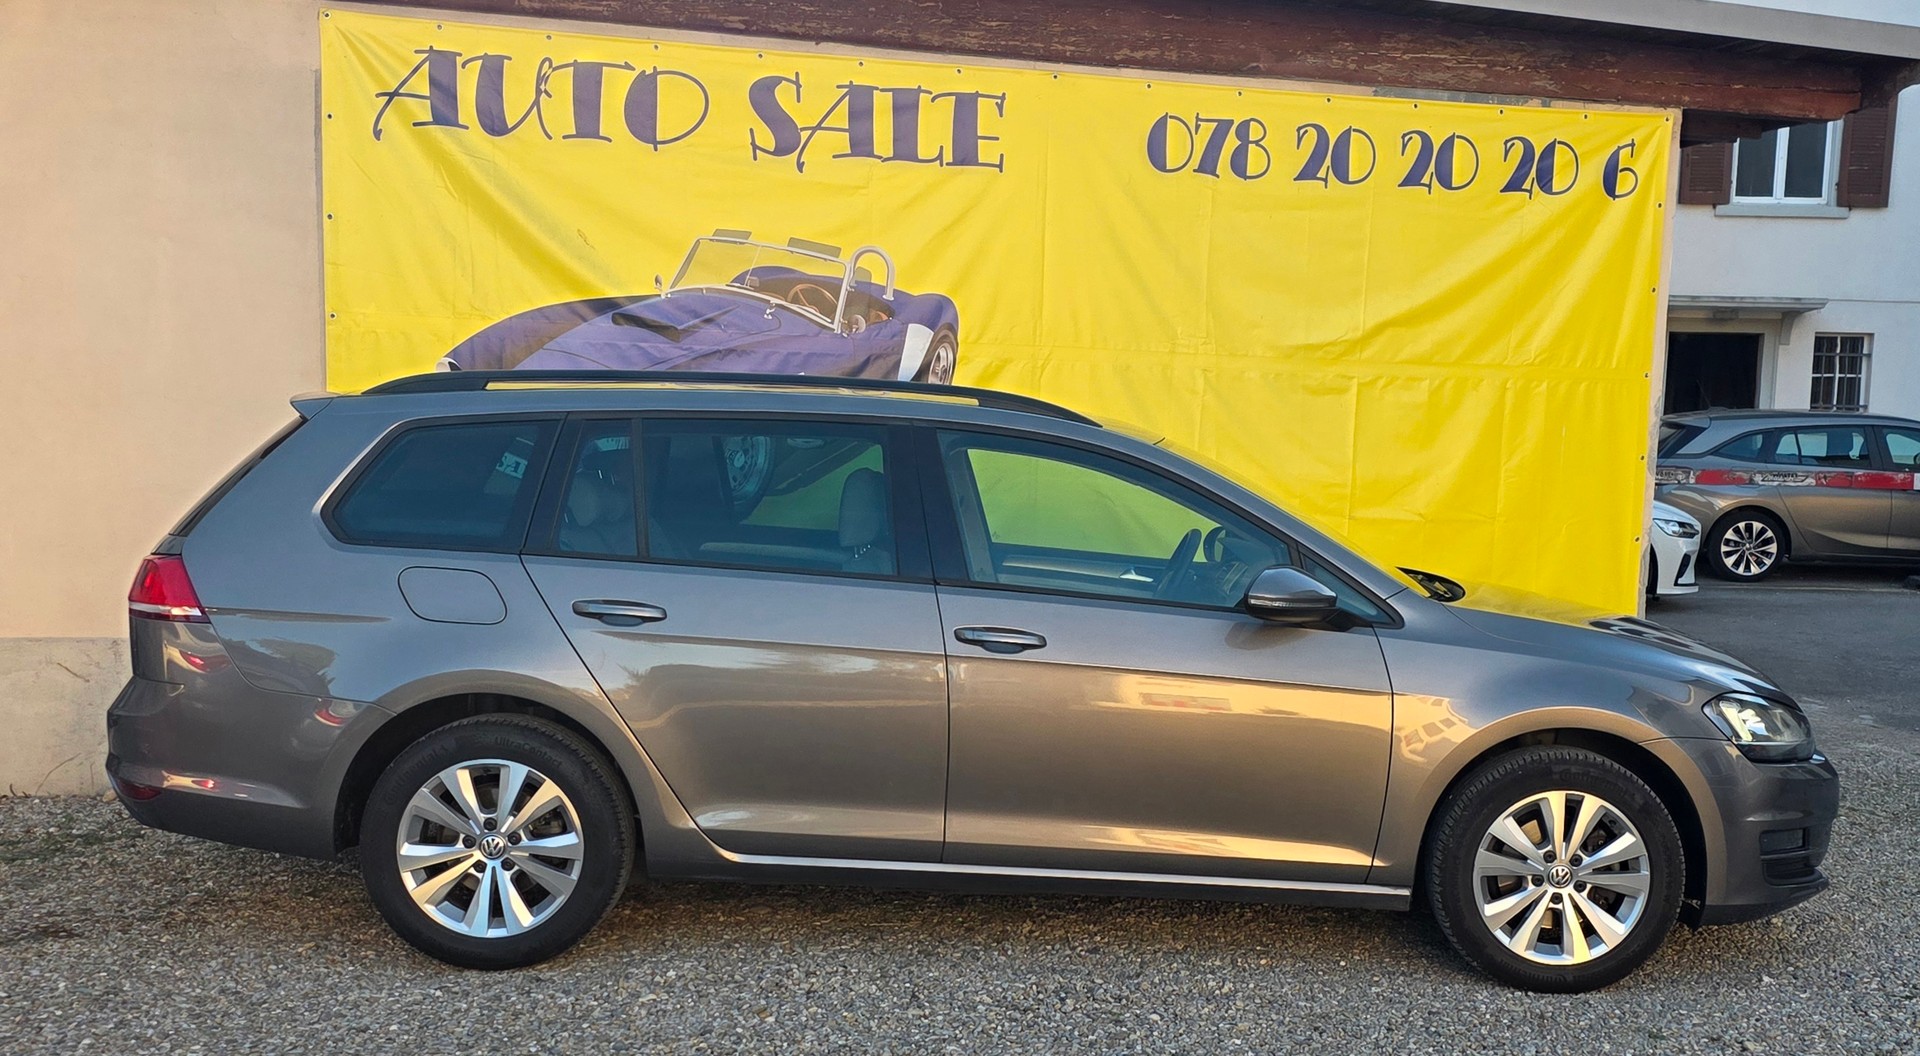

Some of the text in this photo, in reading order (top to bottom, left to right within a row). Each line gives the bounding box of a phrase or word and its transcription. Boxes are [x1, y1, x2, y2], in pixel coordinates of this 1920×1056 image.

[373, 45, 1007, 174] AUTO SALE
[1146, 112, 1638, 200] 078 20 20 20 6
